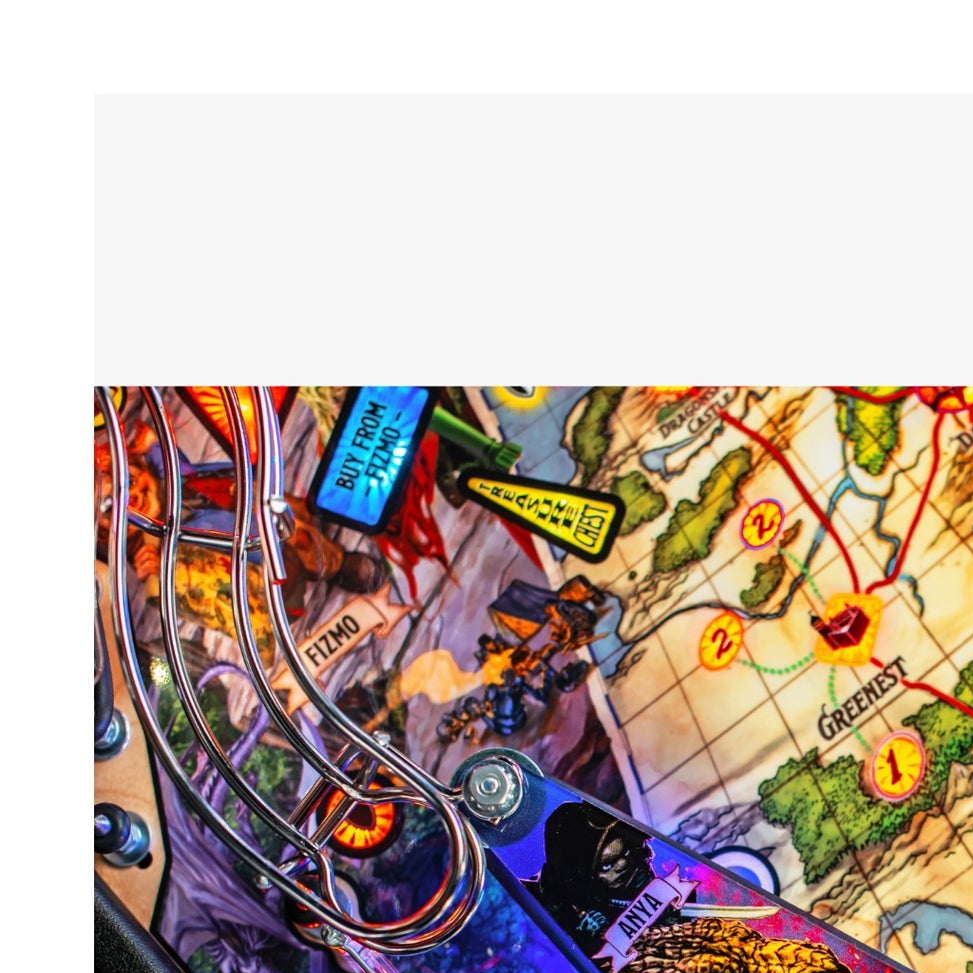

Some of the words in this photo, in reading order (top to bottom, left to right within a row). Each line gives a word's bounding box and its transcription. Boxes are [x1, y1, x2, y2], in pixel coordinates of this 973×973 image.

[335, 452, 365, 491] BUY
[351, 401, 388, 451] FROM
[365, 427, 402, 482] FIZMO
[478, 482, 579, 529] TREASURE
[573, 503, 609, 548] CHEST
[752, 514, 775, 540] 2
[304, 614, 360, 667] FIZMO
[711, 628, 733, 660] 2
[817, 656, 909, 741] GREENEST
[886, 748, 903, 785] 1
[617, 892, 663, 939] ANYA
